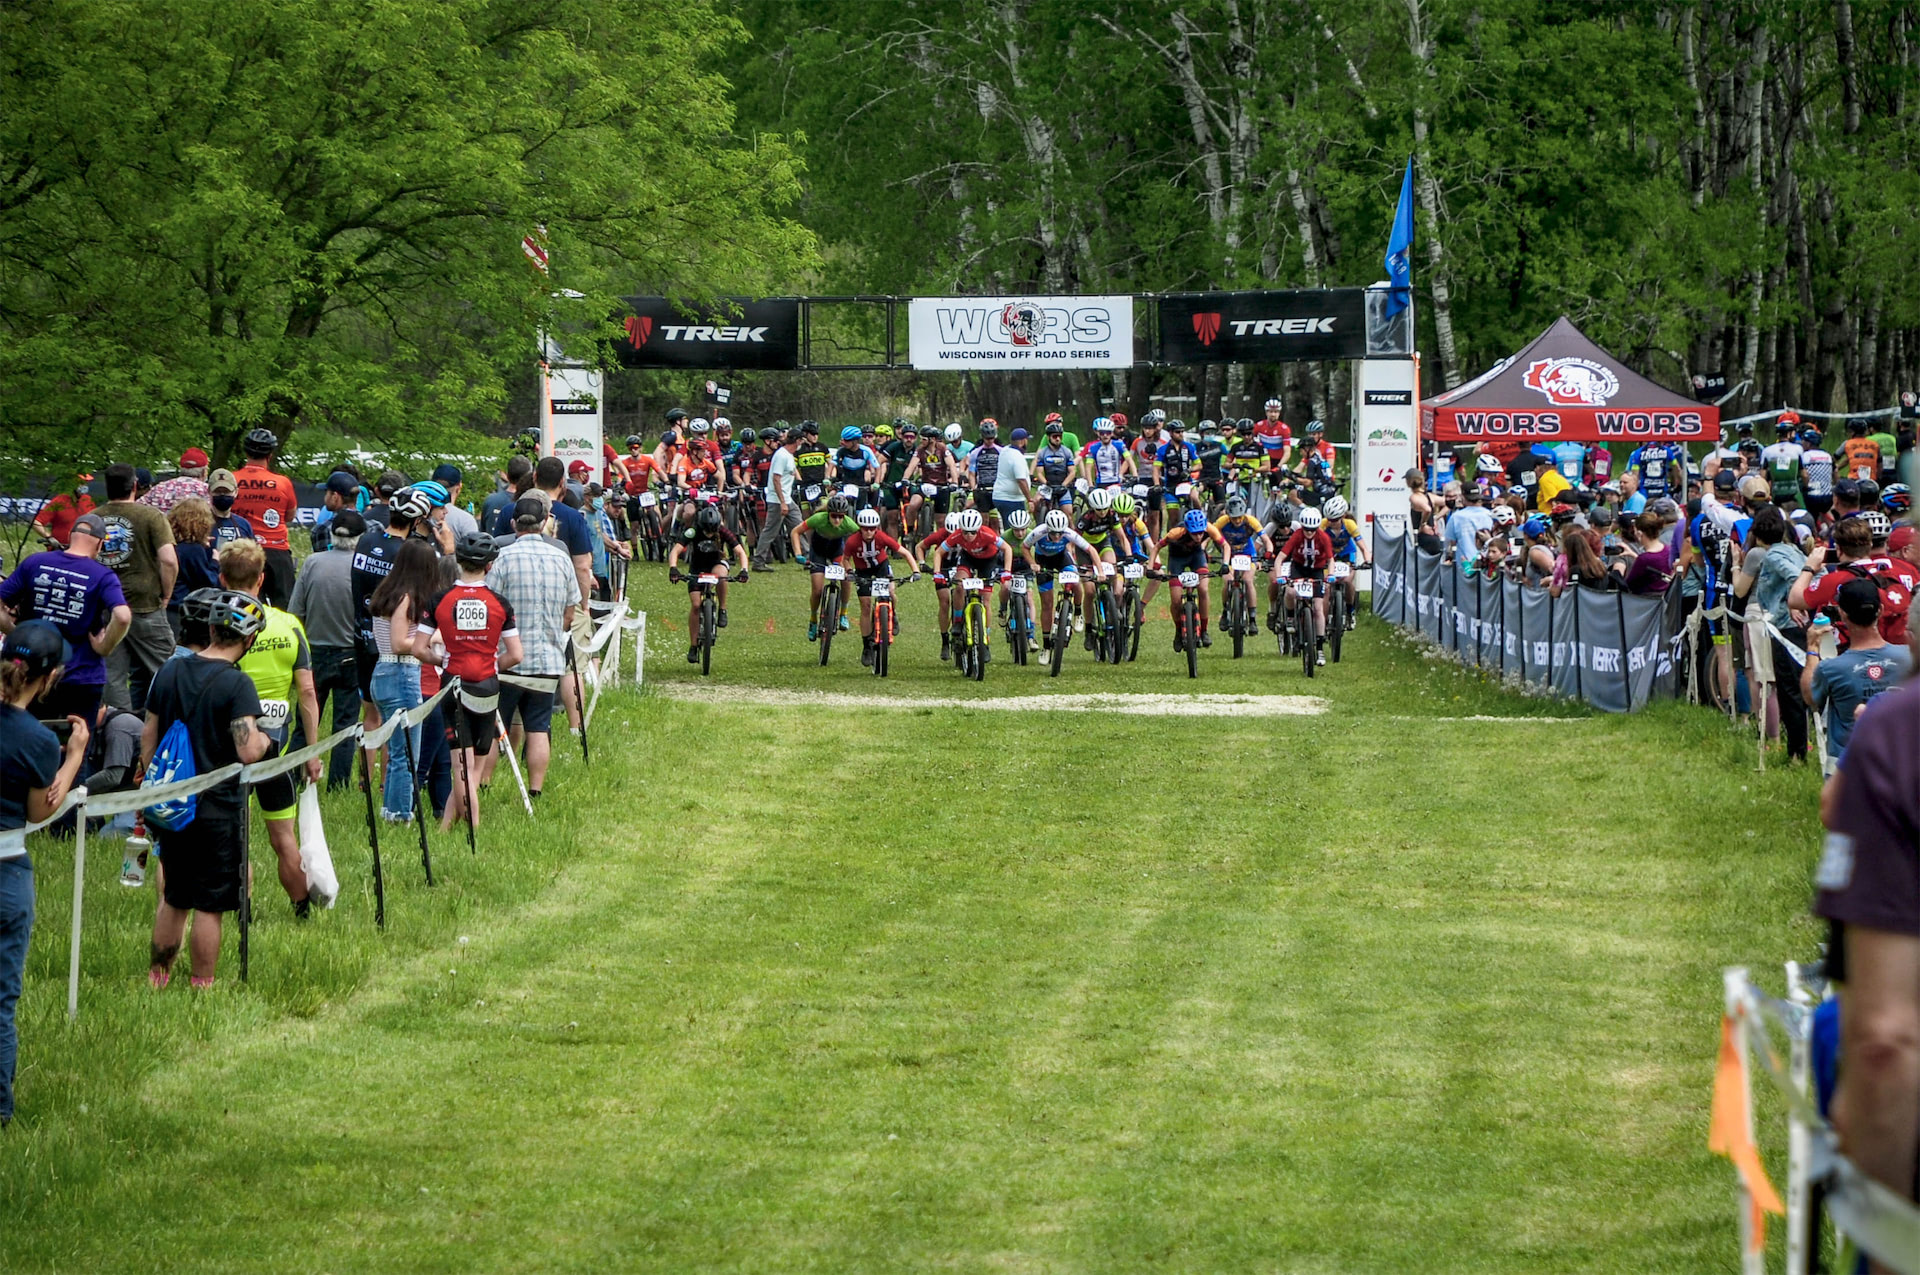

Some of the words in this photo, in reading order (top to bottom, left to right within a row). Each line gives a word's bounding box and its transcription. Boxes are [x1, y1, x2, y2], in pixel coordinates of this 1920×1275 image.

[936, 307, 1112, 345] WORS
[1229, 316, 1338, 336] TREK
[660, 325, 770, 342] TREK
[938, 350, 1007, 360] WISCONSIN
[1010, 350, 1031, 359] OFF
[1034, 350, 1067, 359] ROAD
[1070, 349, 1111, 359] SERIES
[1369, 394, 1407, 402] TREK
[554, 403, 592, 411] TREK
[1455, 412, 1562, 436] WORS
[1595, 412, 1703, 436] WORS
[237, 479, 277, 490] ANG
[365, 565, 390, 577] EXPRES
[827, 566, 844, 575] 239
[1179, 573, 1197, 583] 220
[1297, 583, 1312, 592] 102
[458, 607, 485, 620] 2066
[254, 635, 289, 647] ICYCLE
[249, 642, 292, 655] DOCTOR
[263, 703, 286, 718] 260
